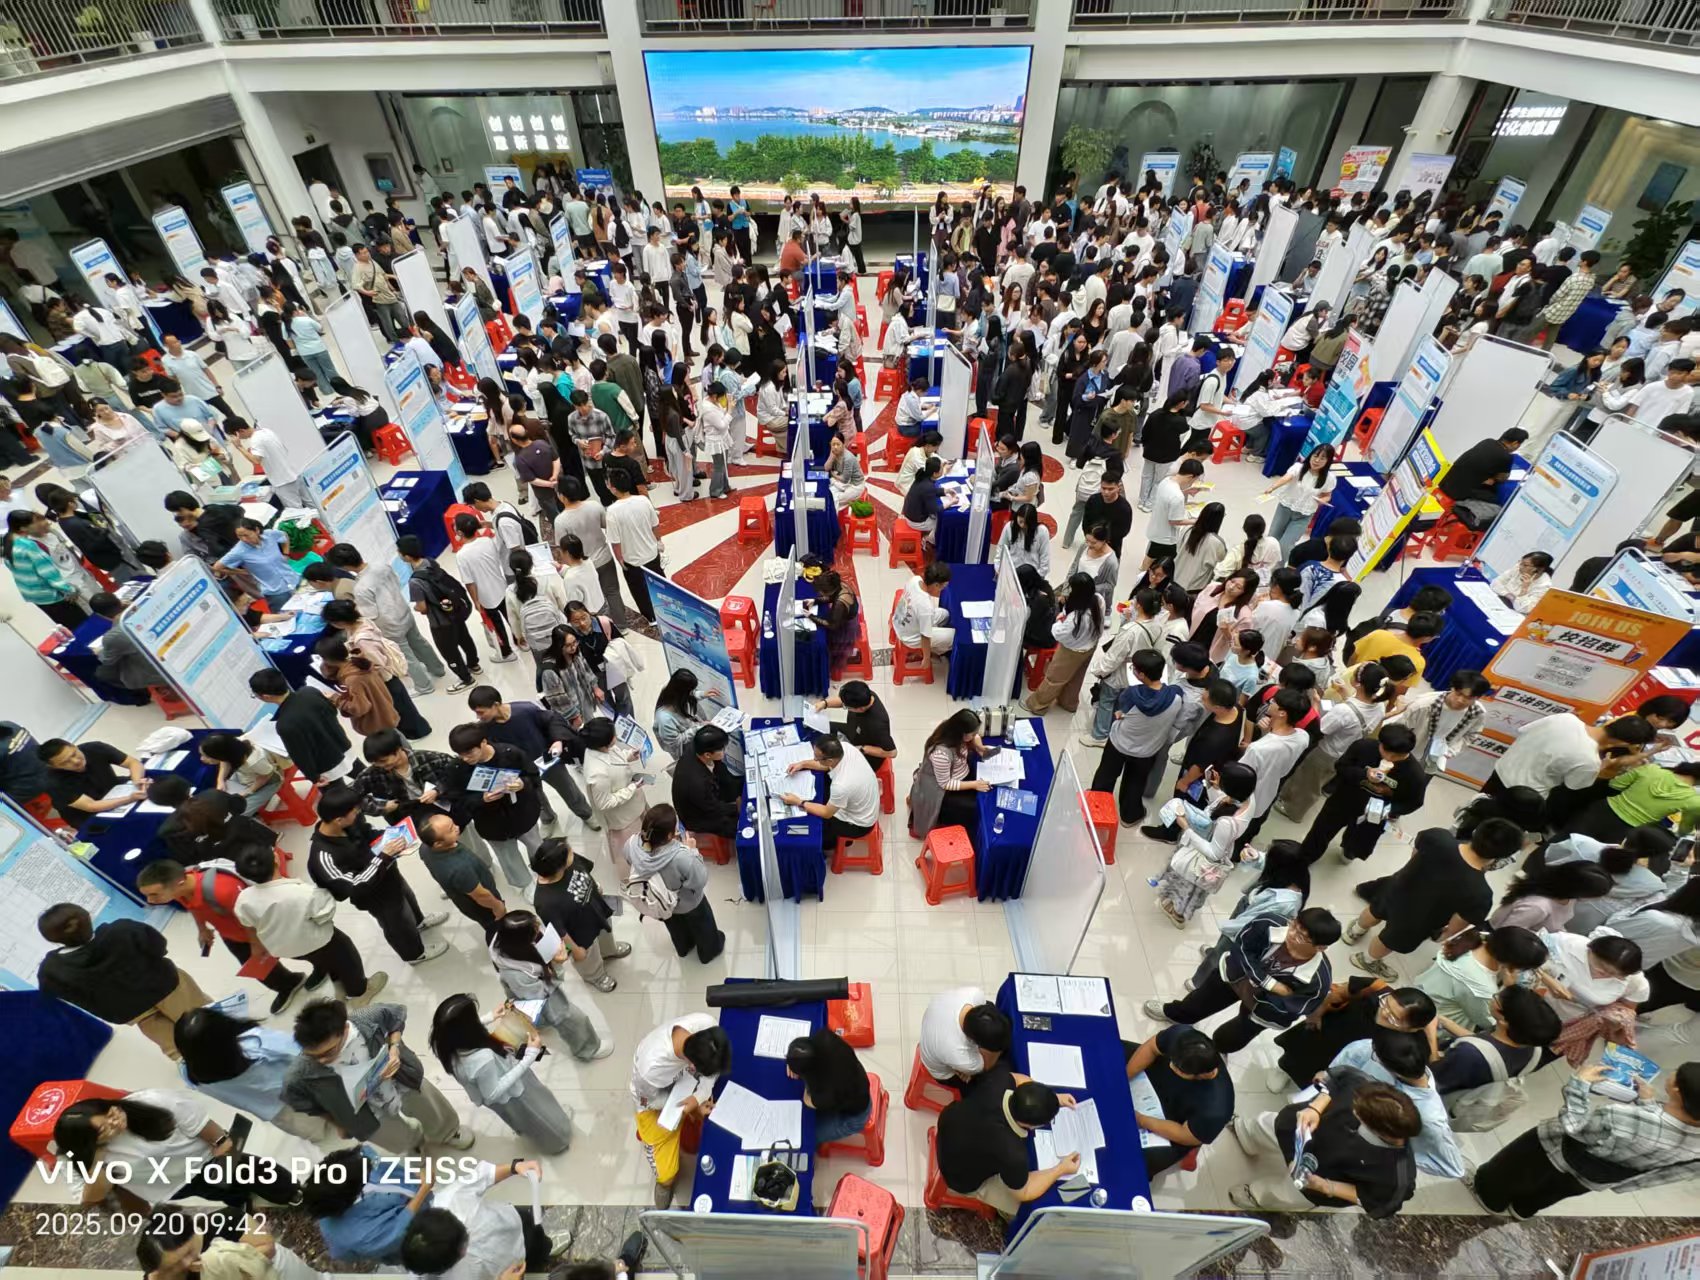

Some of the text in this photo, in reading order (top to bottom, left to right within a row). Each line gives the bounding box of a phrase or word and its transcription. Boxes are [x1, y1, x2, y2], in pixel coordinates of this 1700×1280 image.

[1568, 610, 1613, 630] JOIN
[1614, 619, 1643, 637] US
[1558, 630, 1621, 653] 校招群
[1498, 690, 1570, 714] 宣讲时间
